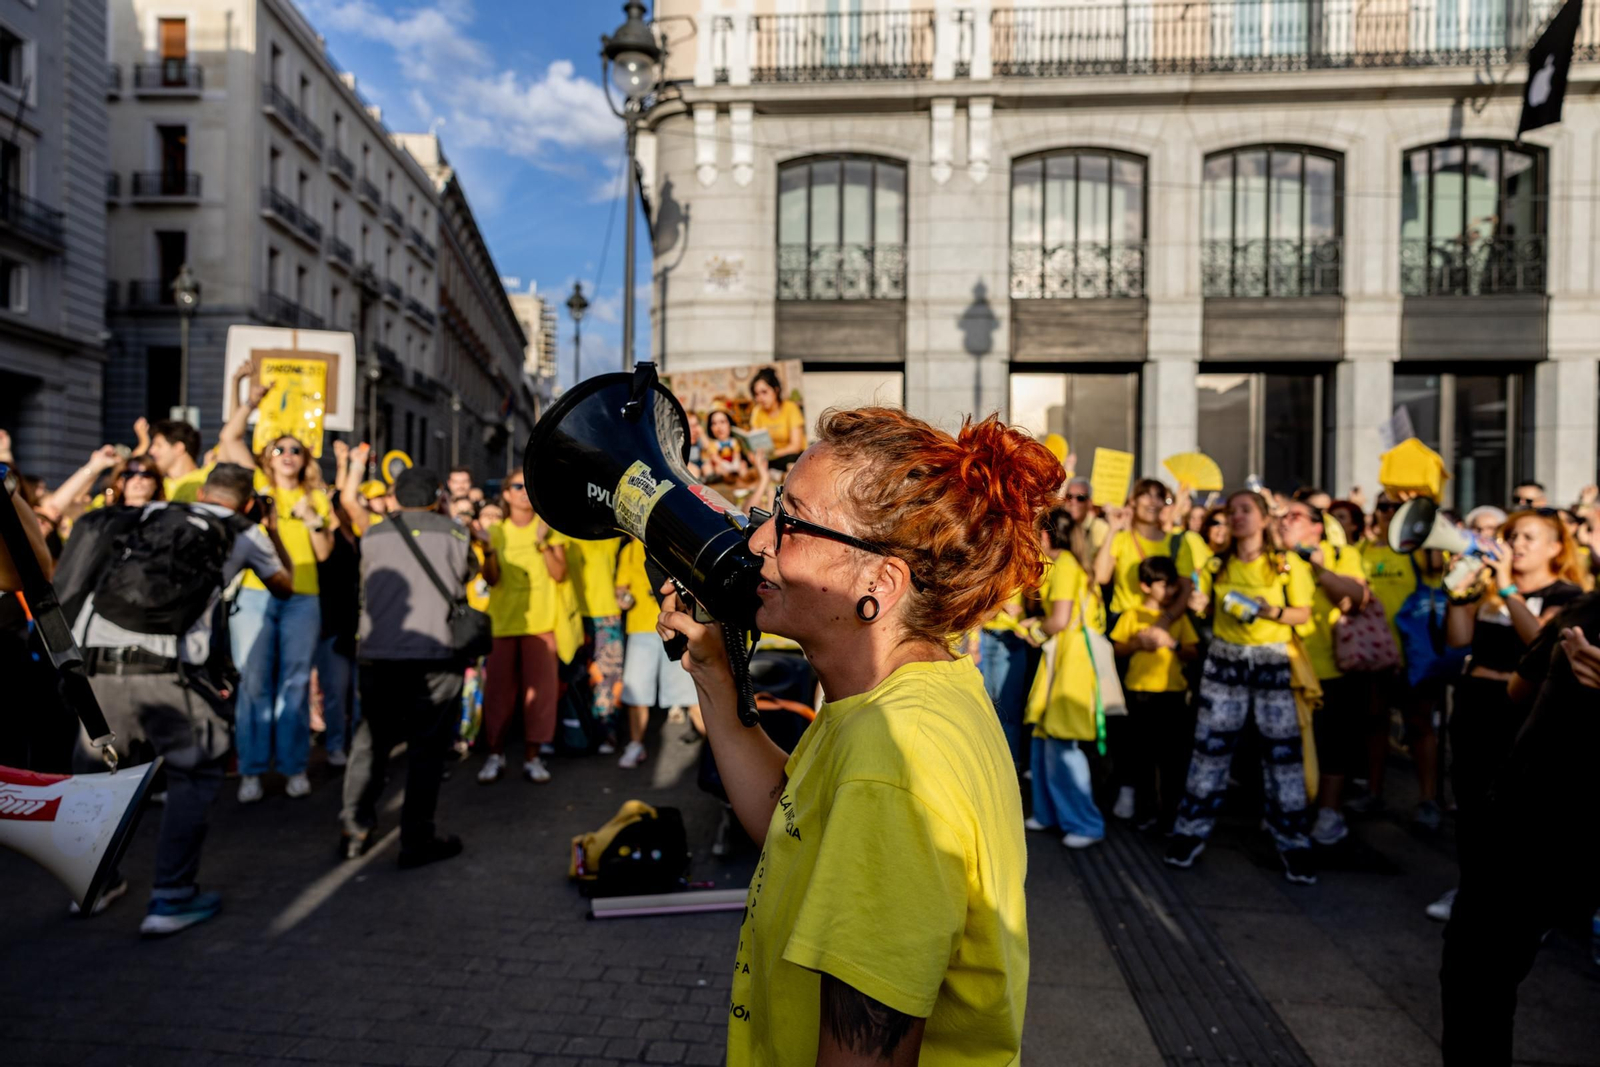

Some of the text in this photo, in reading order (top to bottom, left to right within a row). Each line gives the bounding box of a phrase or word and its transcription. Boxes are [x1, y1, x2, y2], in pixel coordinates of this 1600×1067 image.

[587, 482, 617, 509] PYL
[627, 475, 657, 499] INDEFINIDA
[780, 794, 792, 811] LA
